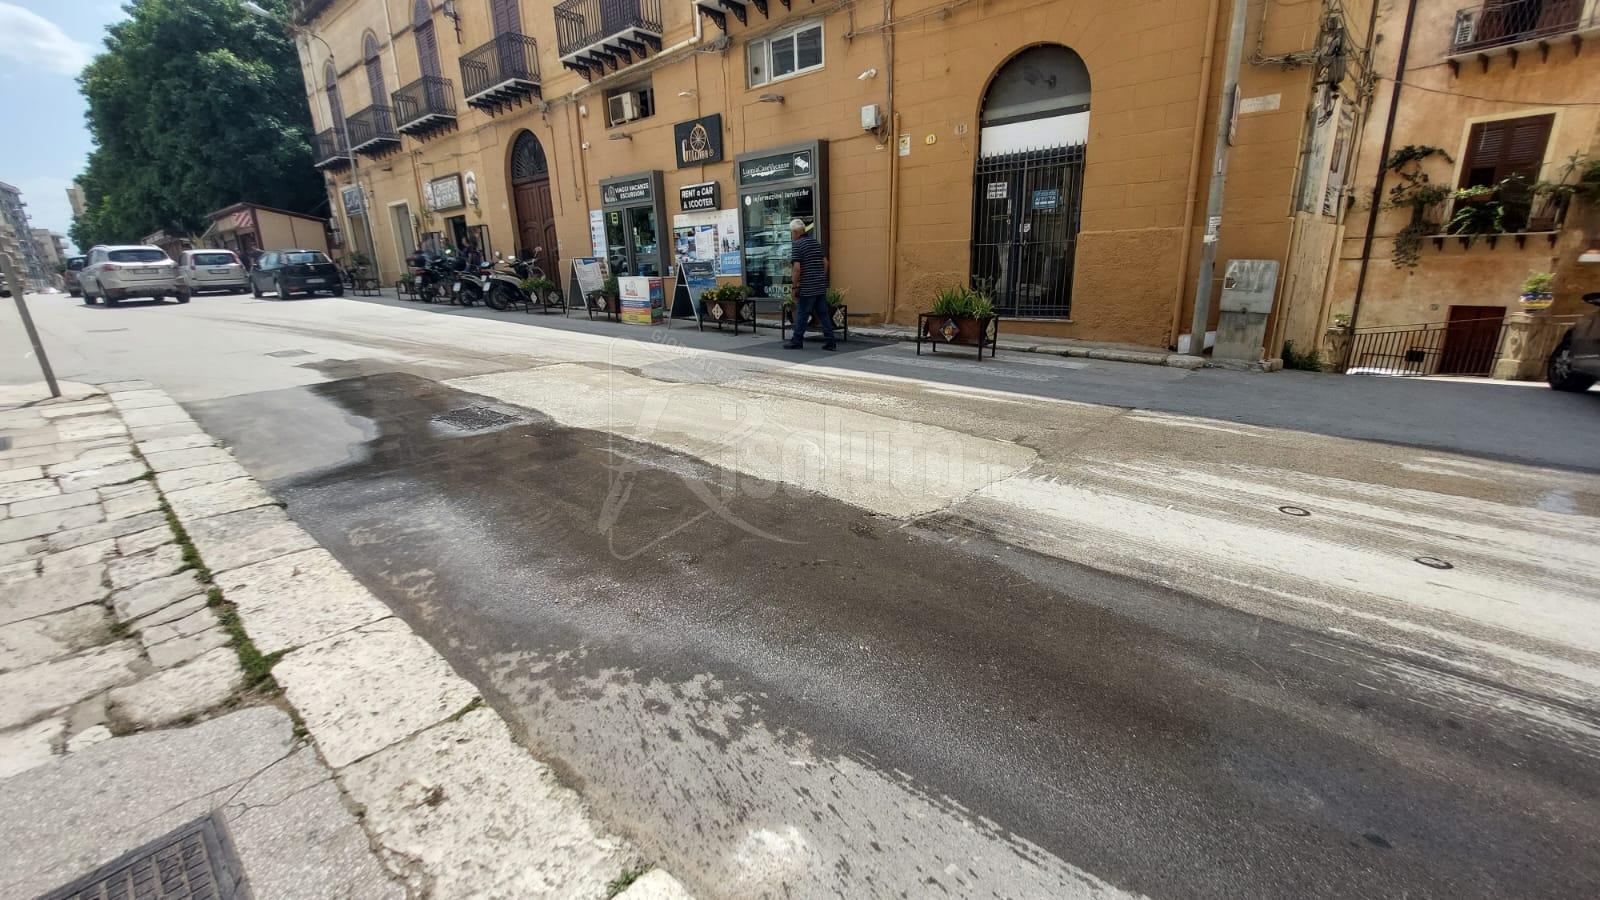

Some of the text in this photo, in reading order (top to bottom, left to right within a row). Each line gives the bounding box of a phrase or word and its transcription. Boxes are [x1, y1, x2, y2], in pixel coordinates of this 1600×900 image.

[681, 190, 696, 198] RENT
[701, 186, 714, 195] CAR
[689, 198, 714, 208] SCOOTER
